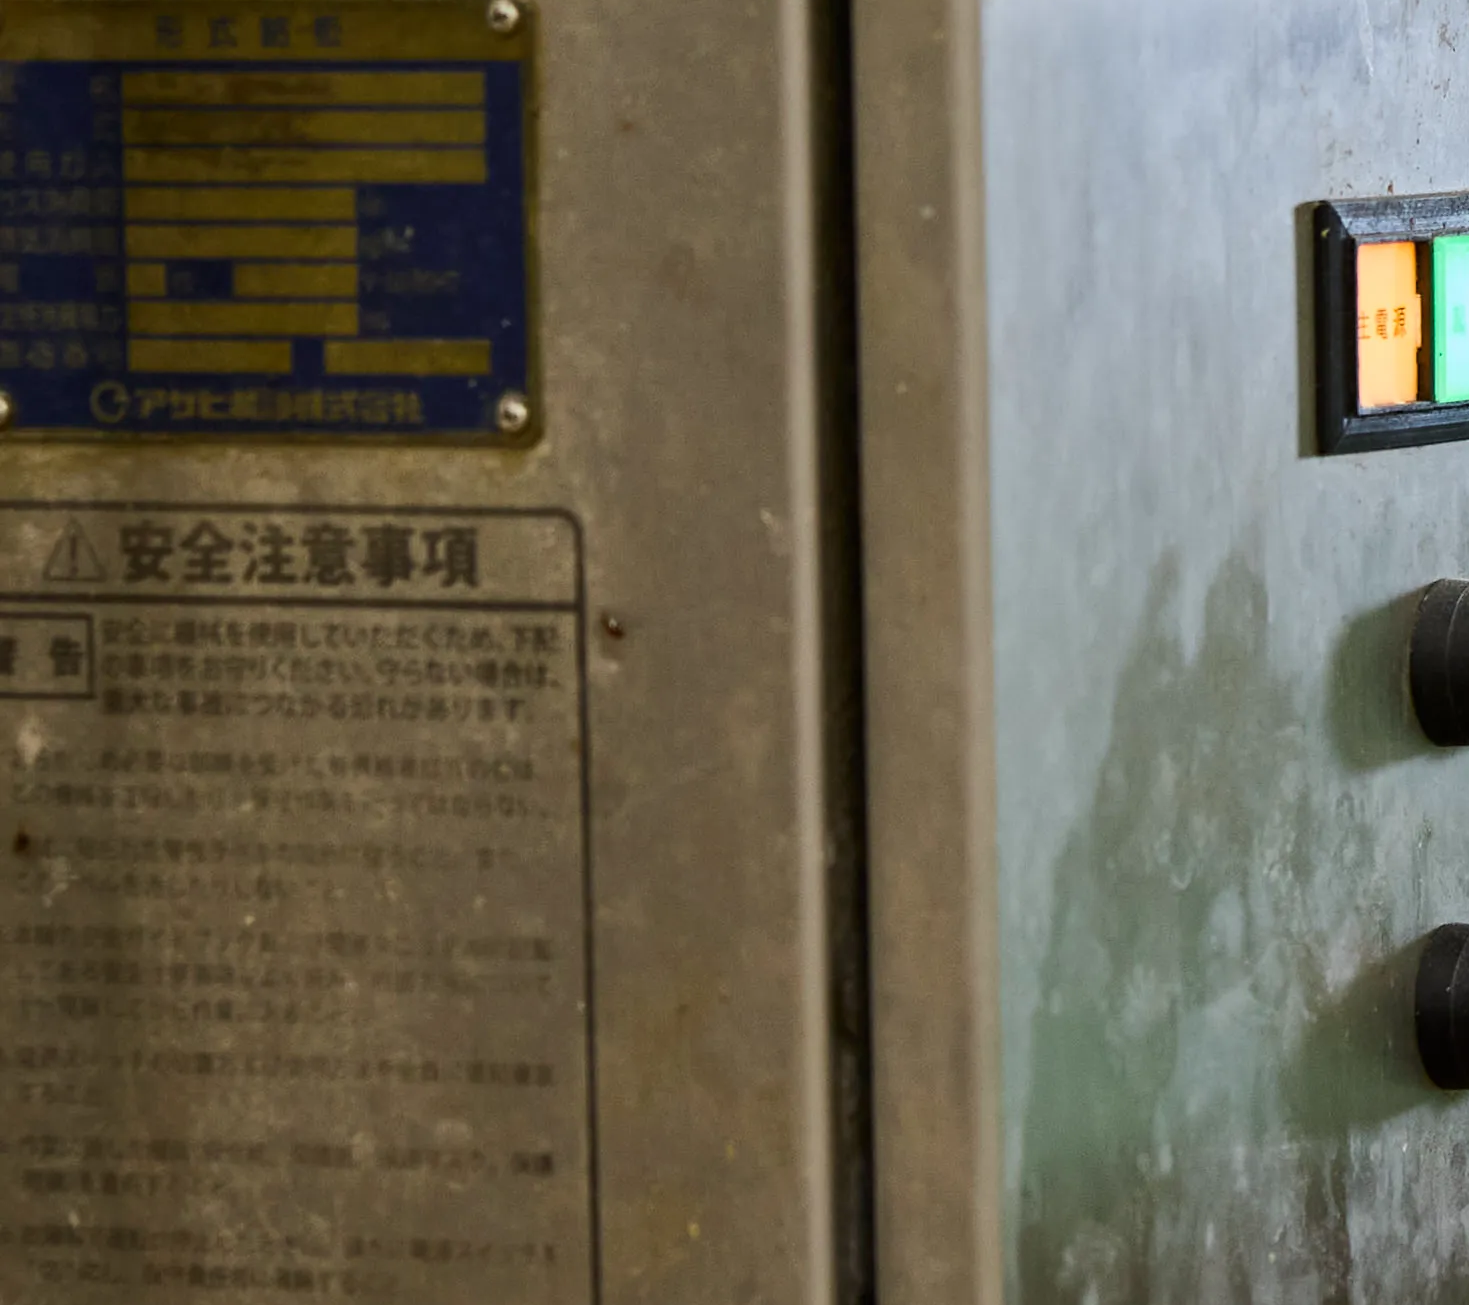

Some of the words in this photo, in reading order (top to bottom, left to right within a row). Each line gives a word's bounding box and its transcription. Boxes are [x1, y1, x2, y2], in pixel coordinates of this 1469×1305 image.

[120, 521, 481, 590] 安全注意事項
